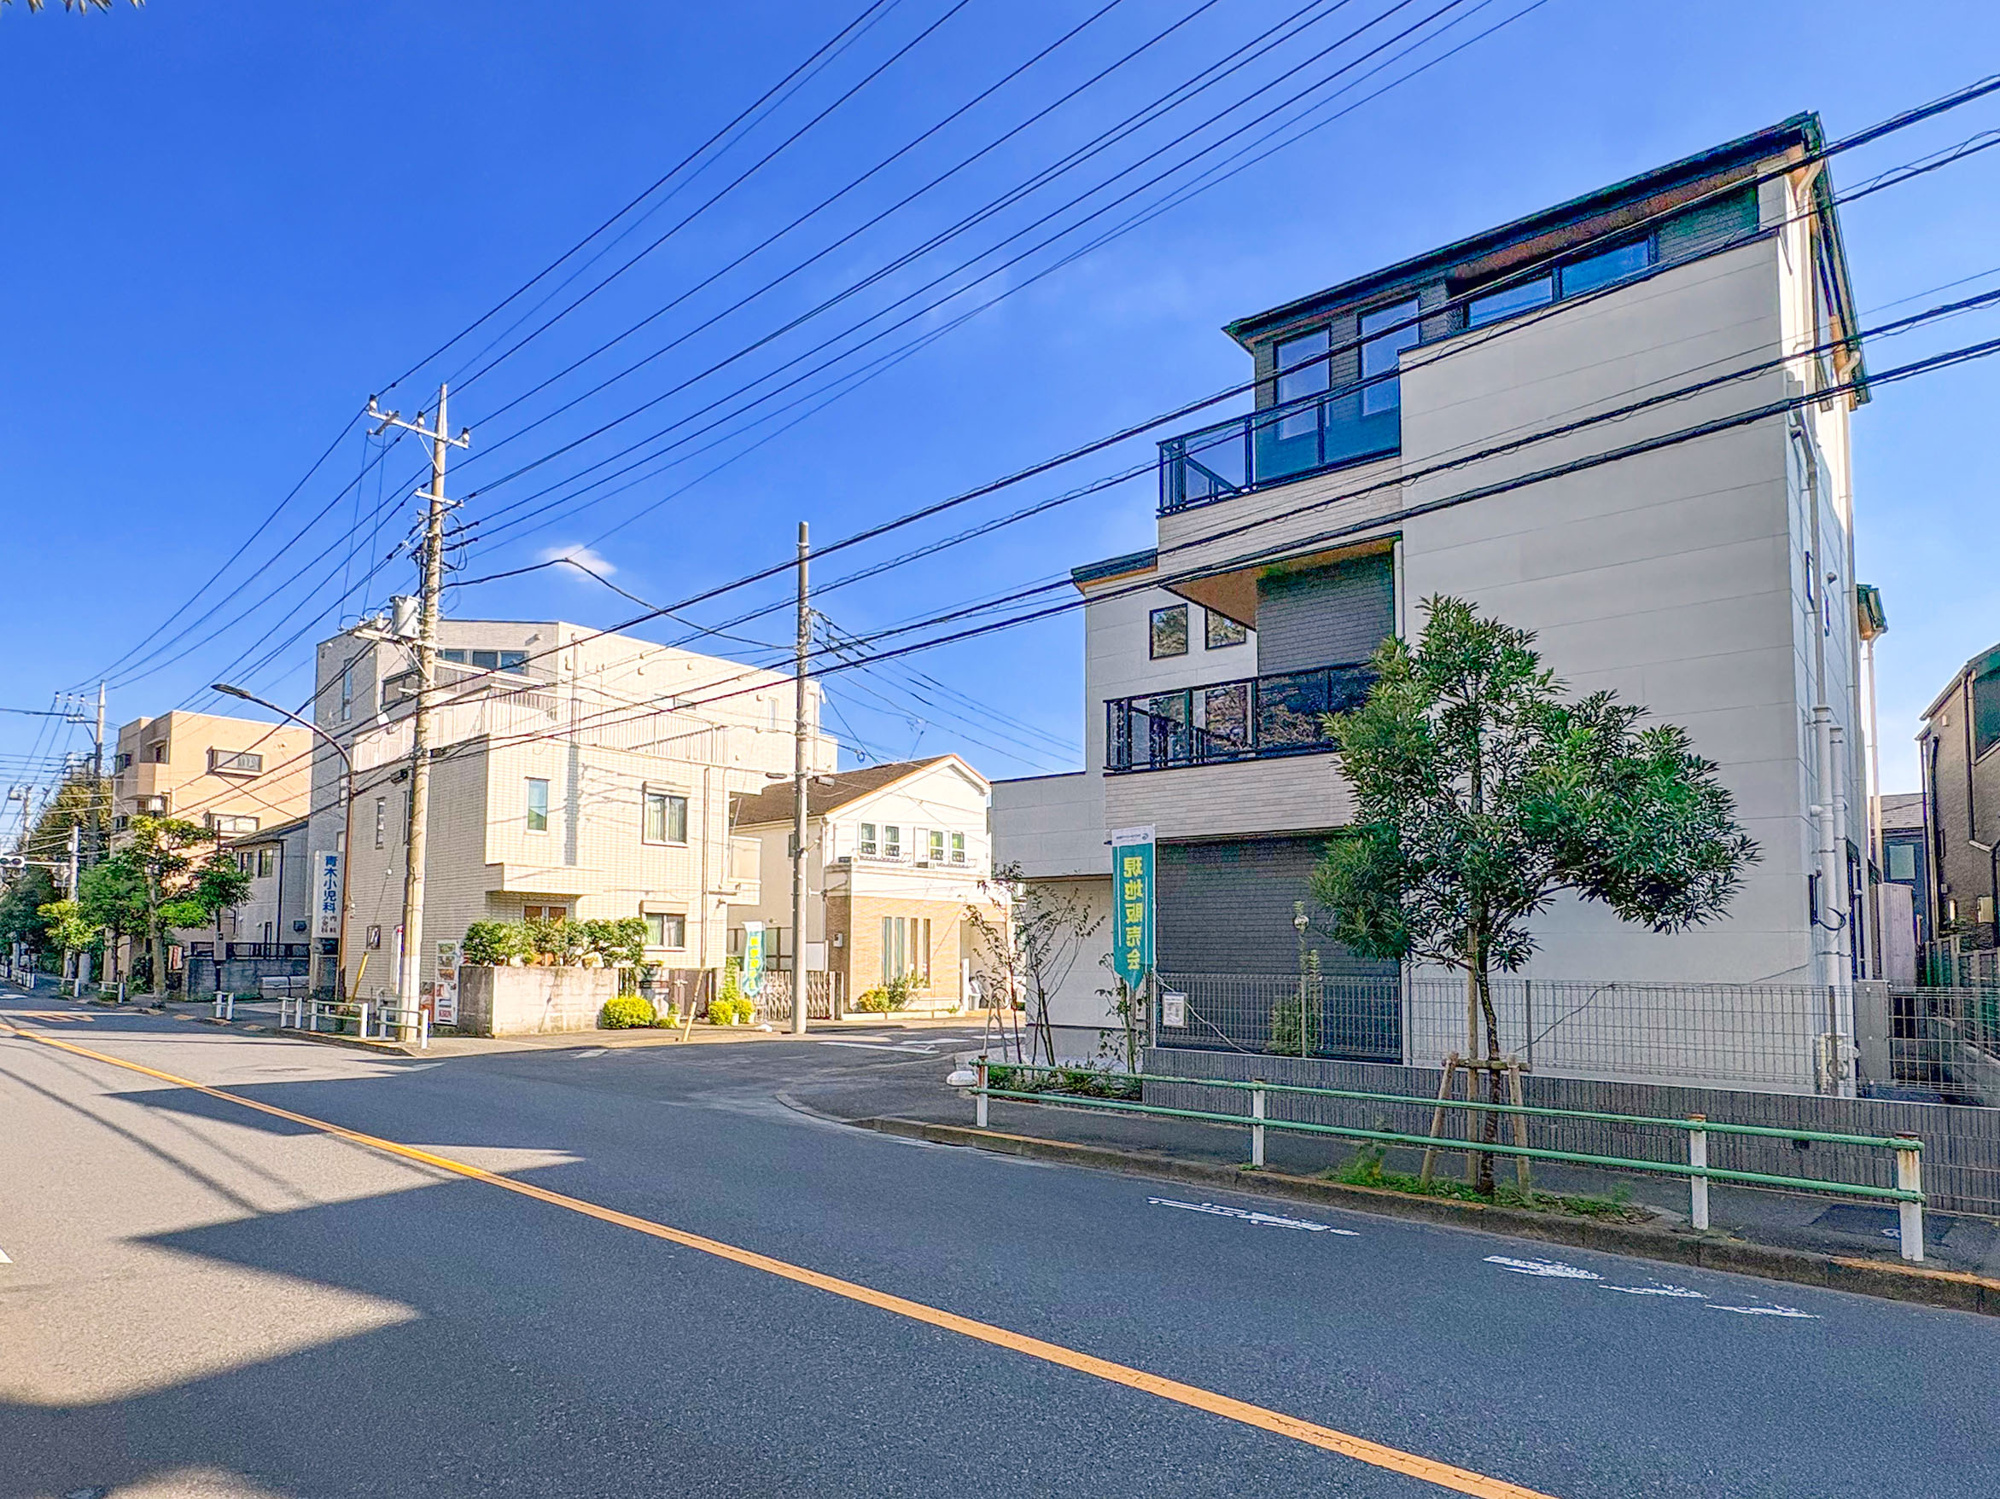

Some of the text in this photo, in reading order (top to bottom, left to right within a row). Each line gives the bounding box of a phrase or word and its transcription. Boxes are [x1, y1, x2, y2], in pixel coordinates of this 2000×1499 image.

[322, 855, 338, 913] 青木小児科
